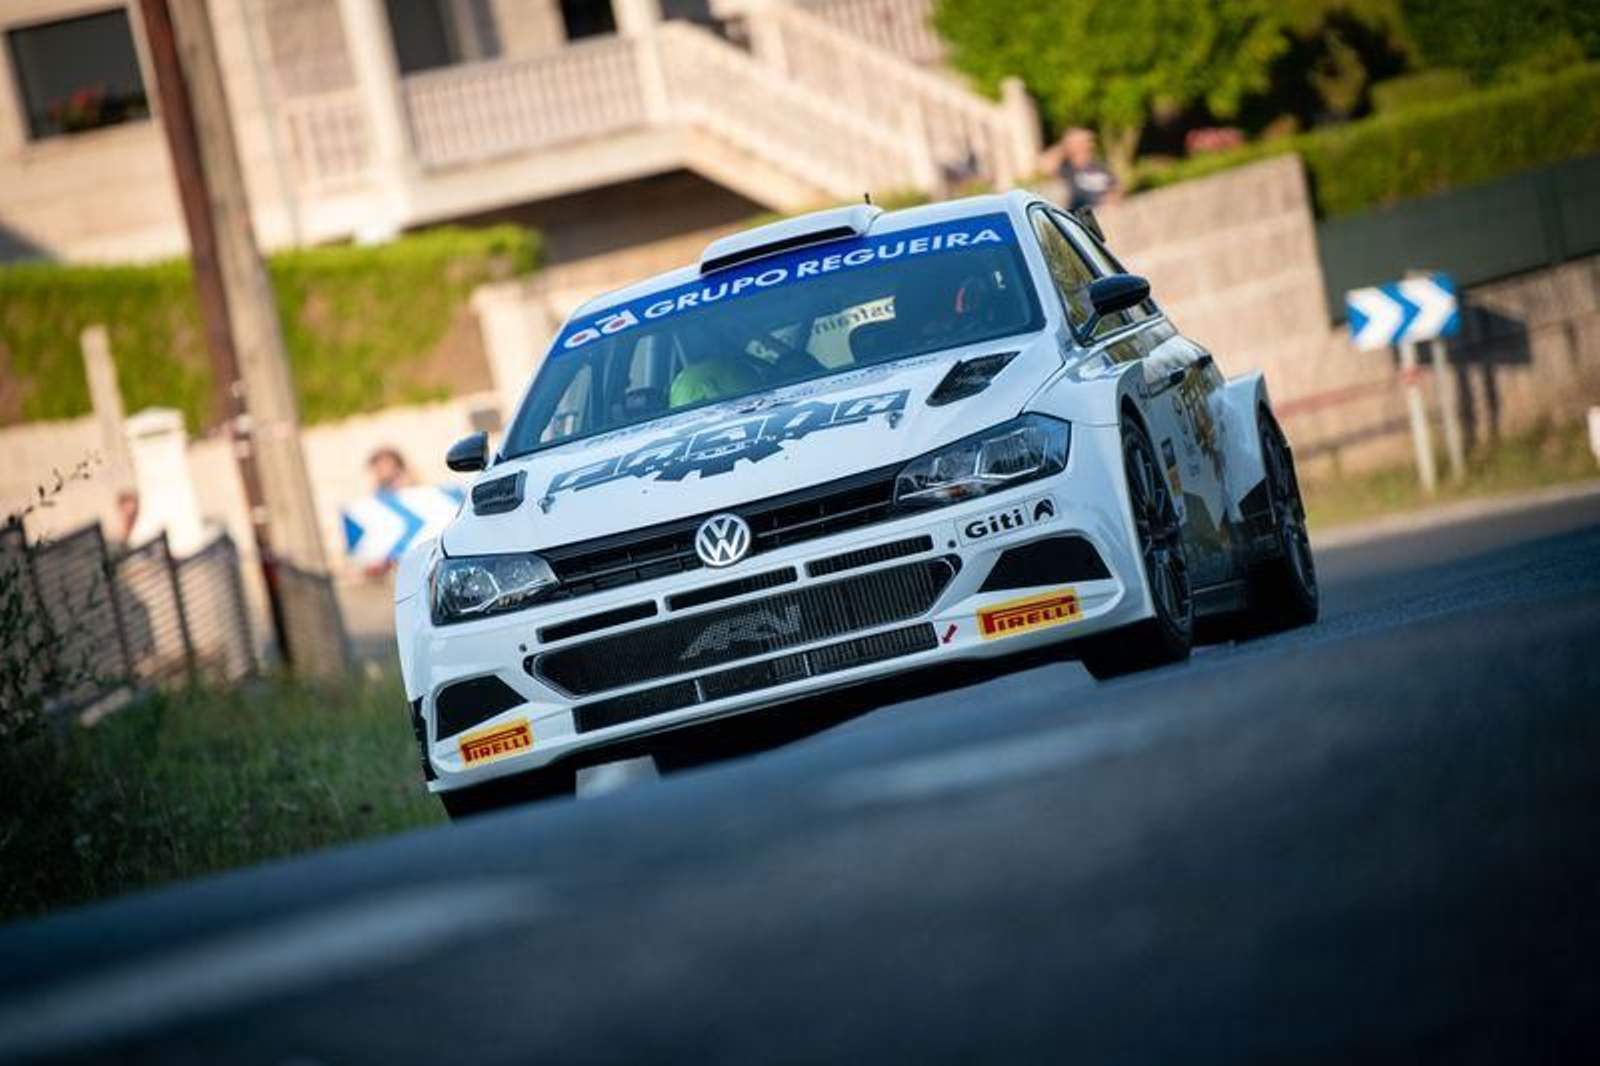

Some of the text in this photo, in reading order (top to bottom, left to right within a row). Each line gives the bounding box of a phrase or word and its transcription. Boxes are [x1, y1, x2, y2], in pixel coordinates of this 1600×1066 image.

[644, 268, 789, 319] GRUPO
[796, 228, 1002, 278] REGUEIRA
[695, 512, 751, 567] VW
[965, 509, 1024, 539] Giti
[981, 595, 1078, 635] PIRELLI
[461, 725, 530, 763] PIRELLI
